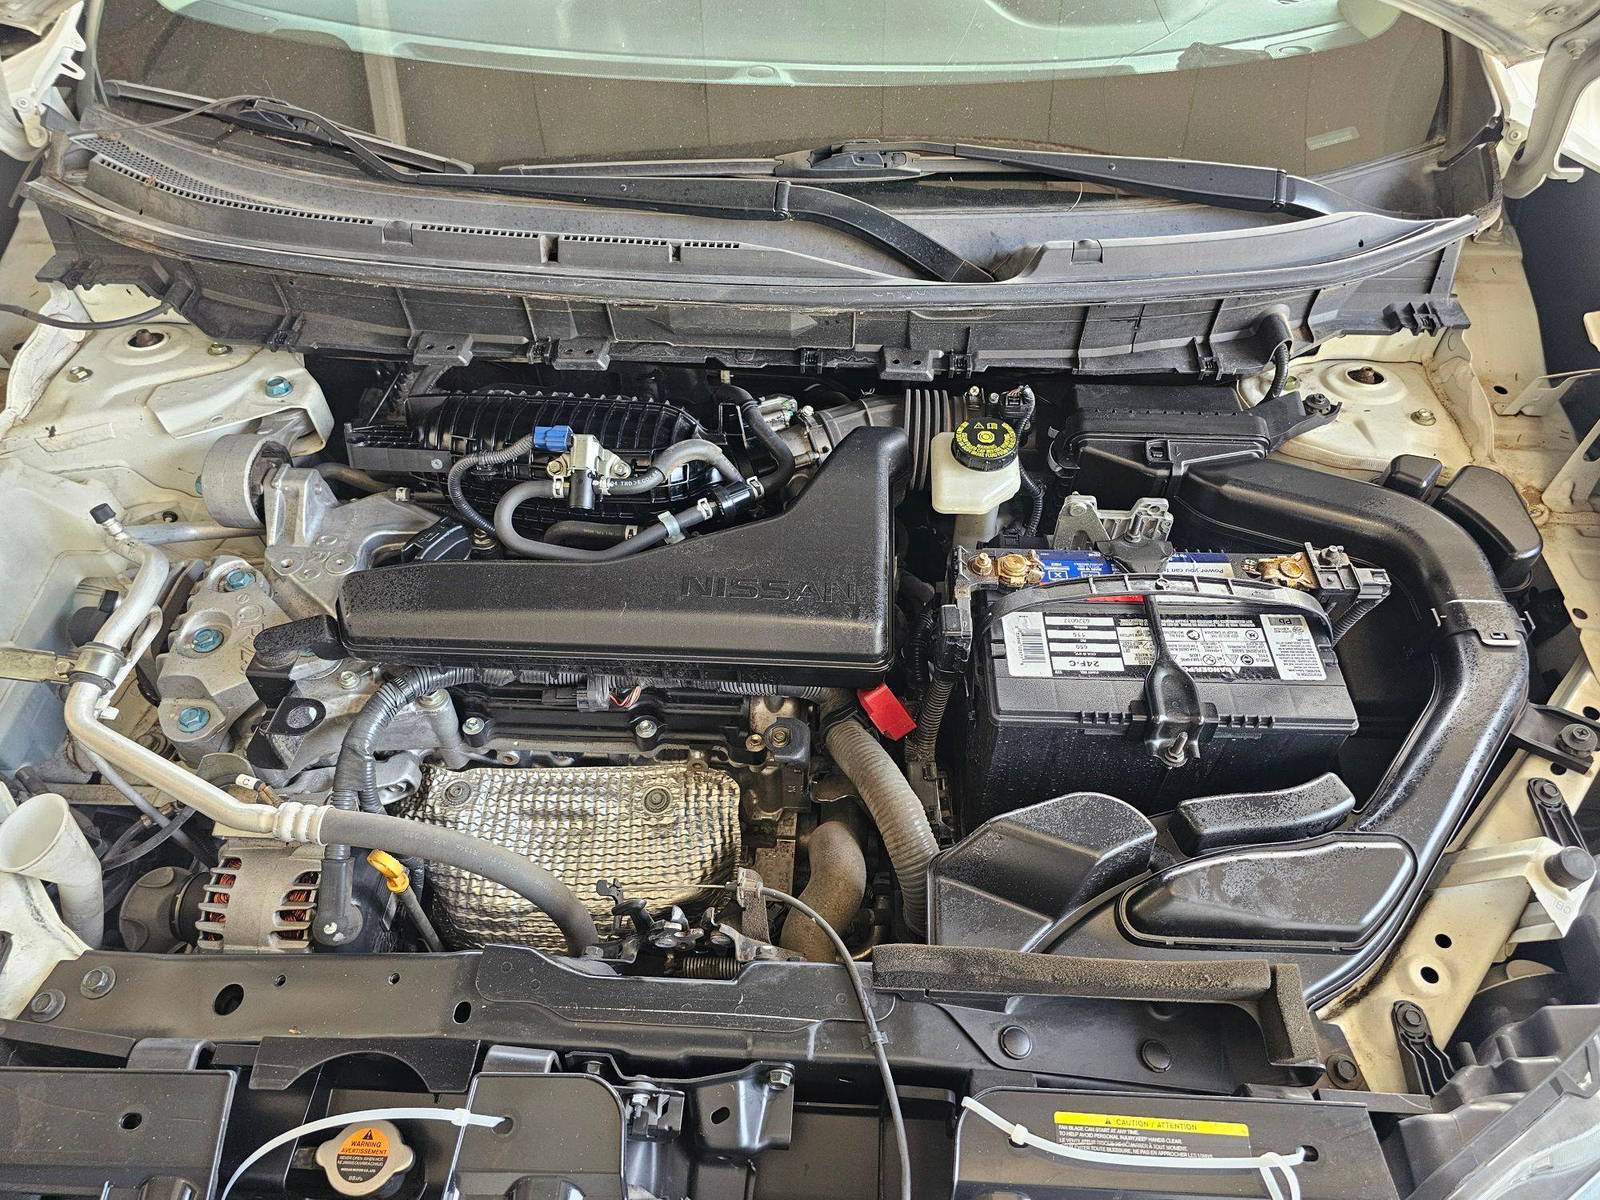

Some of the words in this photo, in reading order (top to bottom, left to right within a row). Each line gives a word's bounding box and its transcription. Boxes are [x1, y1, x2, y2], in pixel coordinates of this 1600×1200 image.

[681, 575, 856, 604] NISSAN
[1116, 1118, 1148, 1127] CAUTION
[1157, 1122, 1197, 1130] ATTENTION
